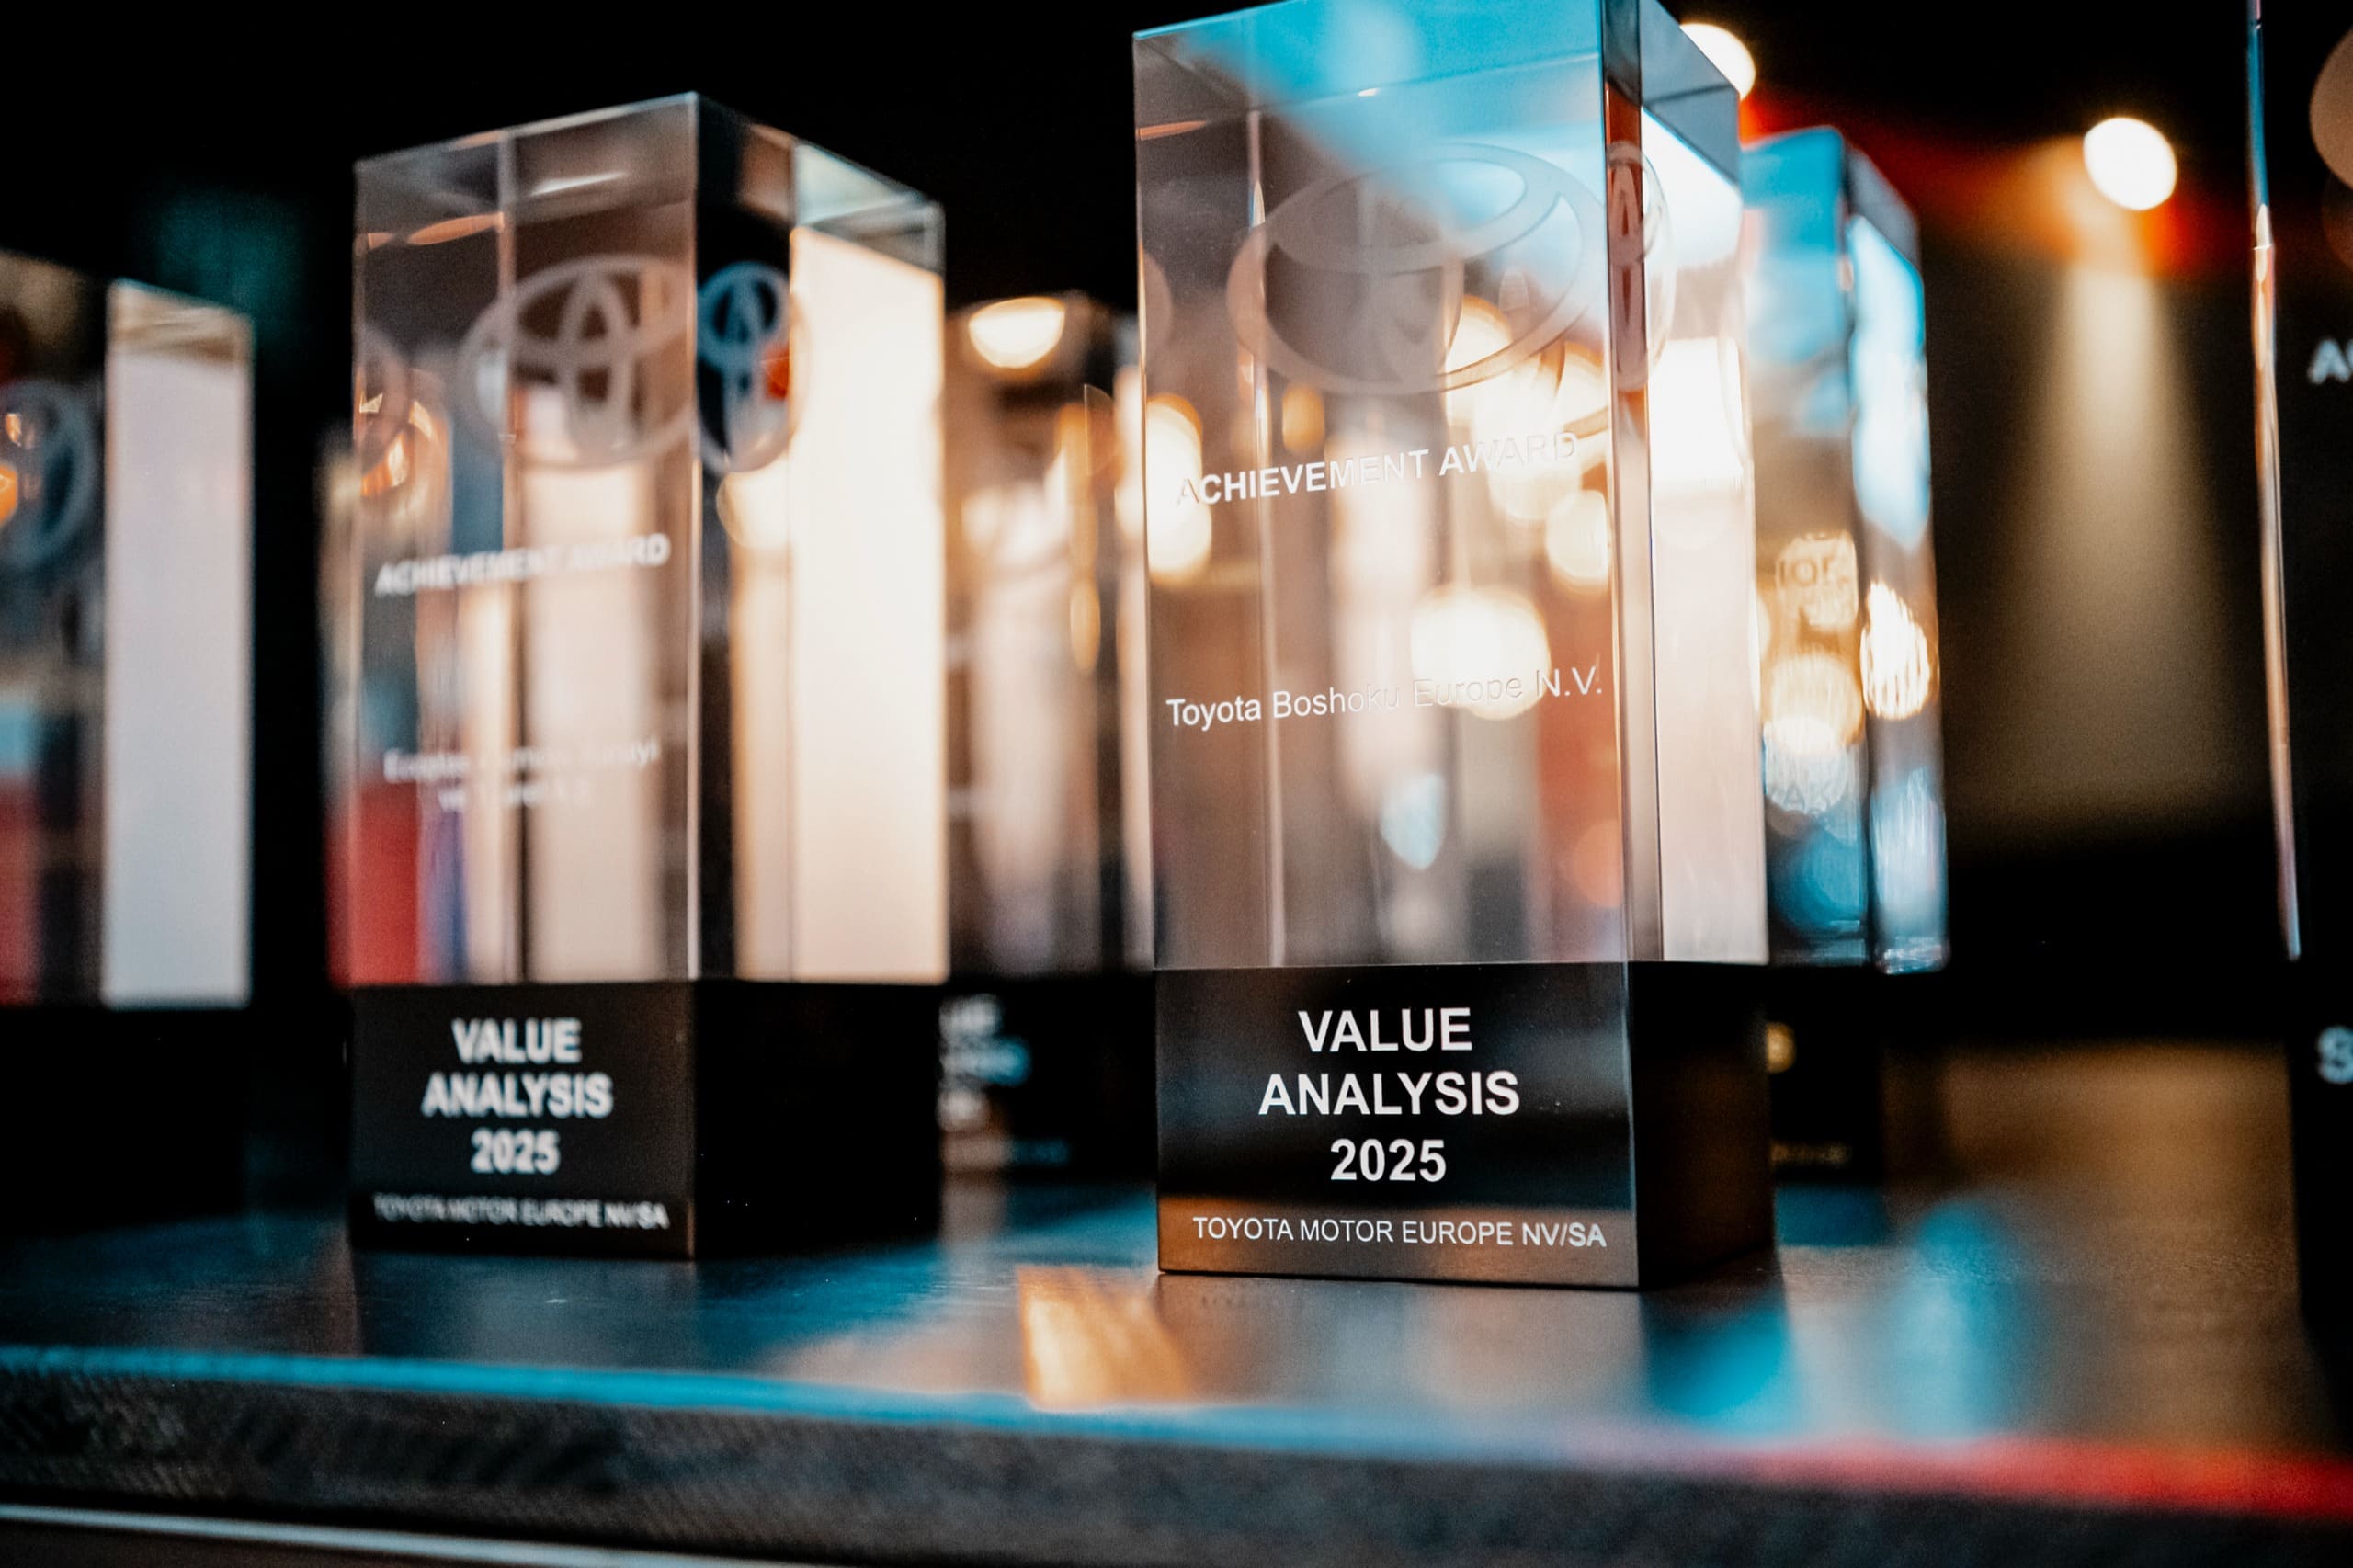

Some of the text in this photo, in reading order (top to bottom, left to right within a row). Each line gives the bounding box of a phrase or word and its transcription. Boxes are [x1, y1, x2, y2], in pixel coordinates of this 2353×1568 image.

[1176, 431, 1579, 506] ACHIEVEMENT AWARD
[1166, 665, 1604, 732] Toyota Boshoku Europe N.V.
[451, 1017, 583, 1063] VALUE
[1298, 1007, 1473, 1052] VALUE
[420, 1071, 614, 1119] ANALYSIS
[1258, 1070, 1520, 1115] ANALYSIS
[470, 1127, 561, 1176] 2025
[1330, 1138, 1447, 1182] 2025
[1193, 1216, 1608, 1248] TOYOTA MOTOR EUROPE NV/SA
